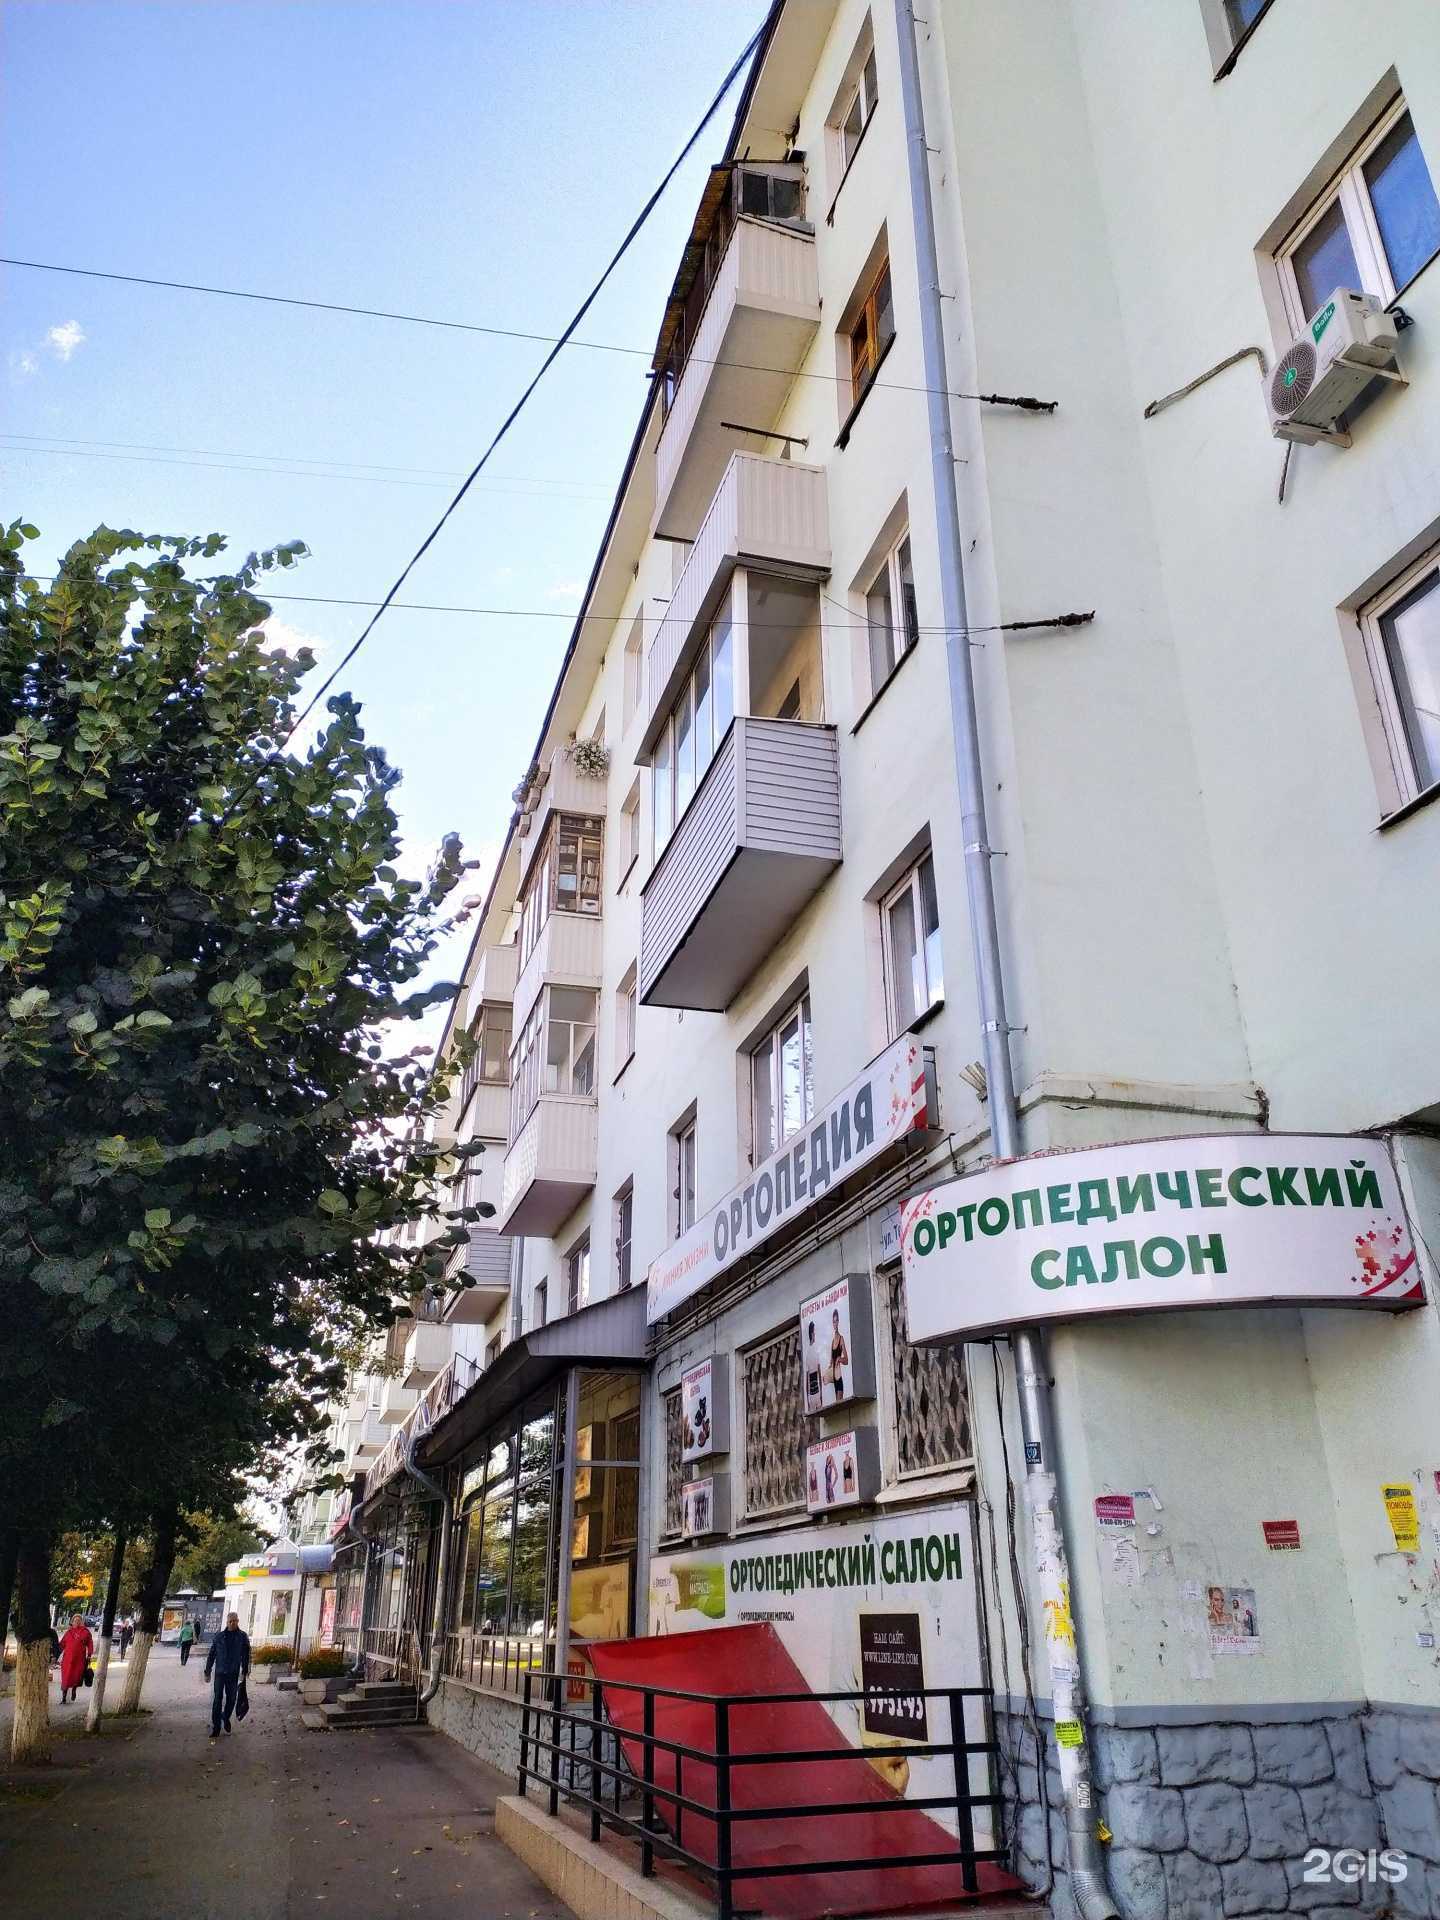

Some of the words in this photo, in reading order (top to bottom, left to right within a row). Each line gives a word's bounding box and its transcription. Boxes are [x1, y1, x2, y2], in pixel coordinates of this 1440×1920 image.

[713, 1081, 875, 1262] ОРТОПЕДИЯ
[913, 1160, 1385, 1257] ОРТОПЕДИЧЕСКИЙ
[1030, 1233, 1228, 1291] САЛОН
[730, 1535, 876, 1596] ОРТОПЕДИЧЕСКИЙ
[880, 1533, 963, 1585] САЛОН
